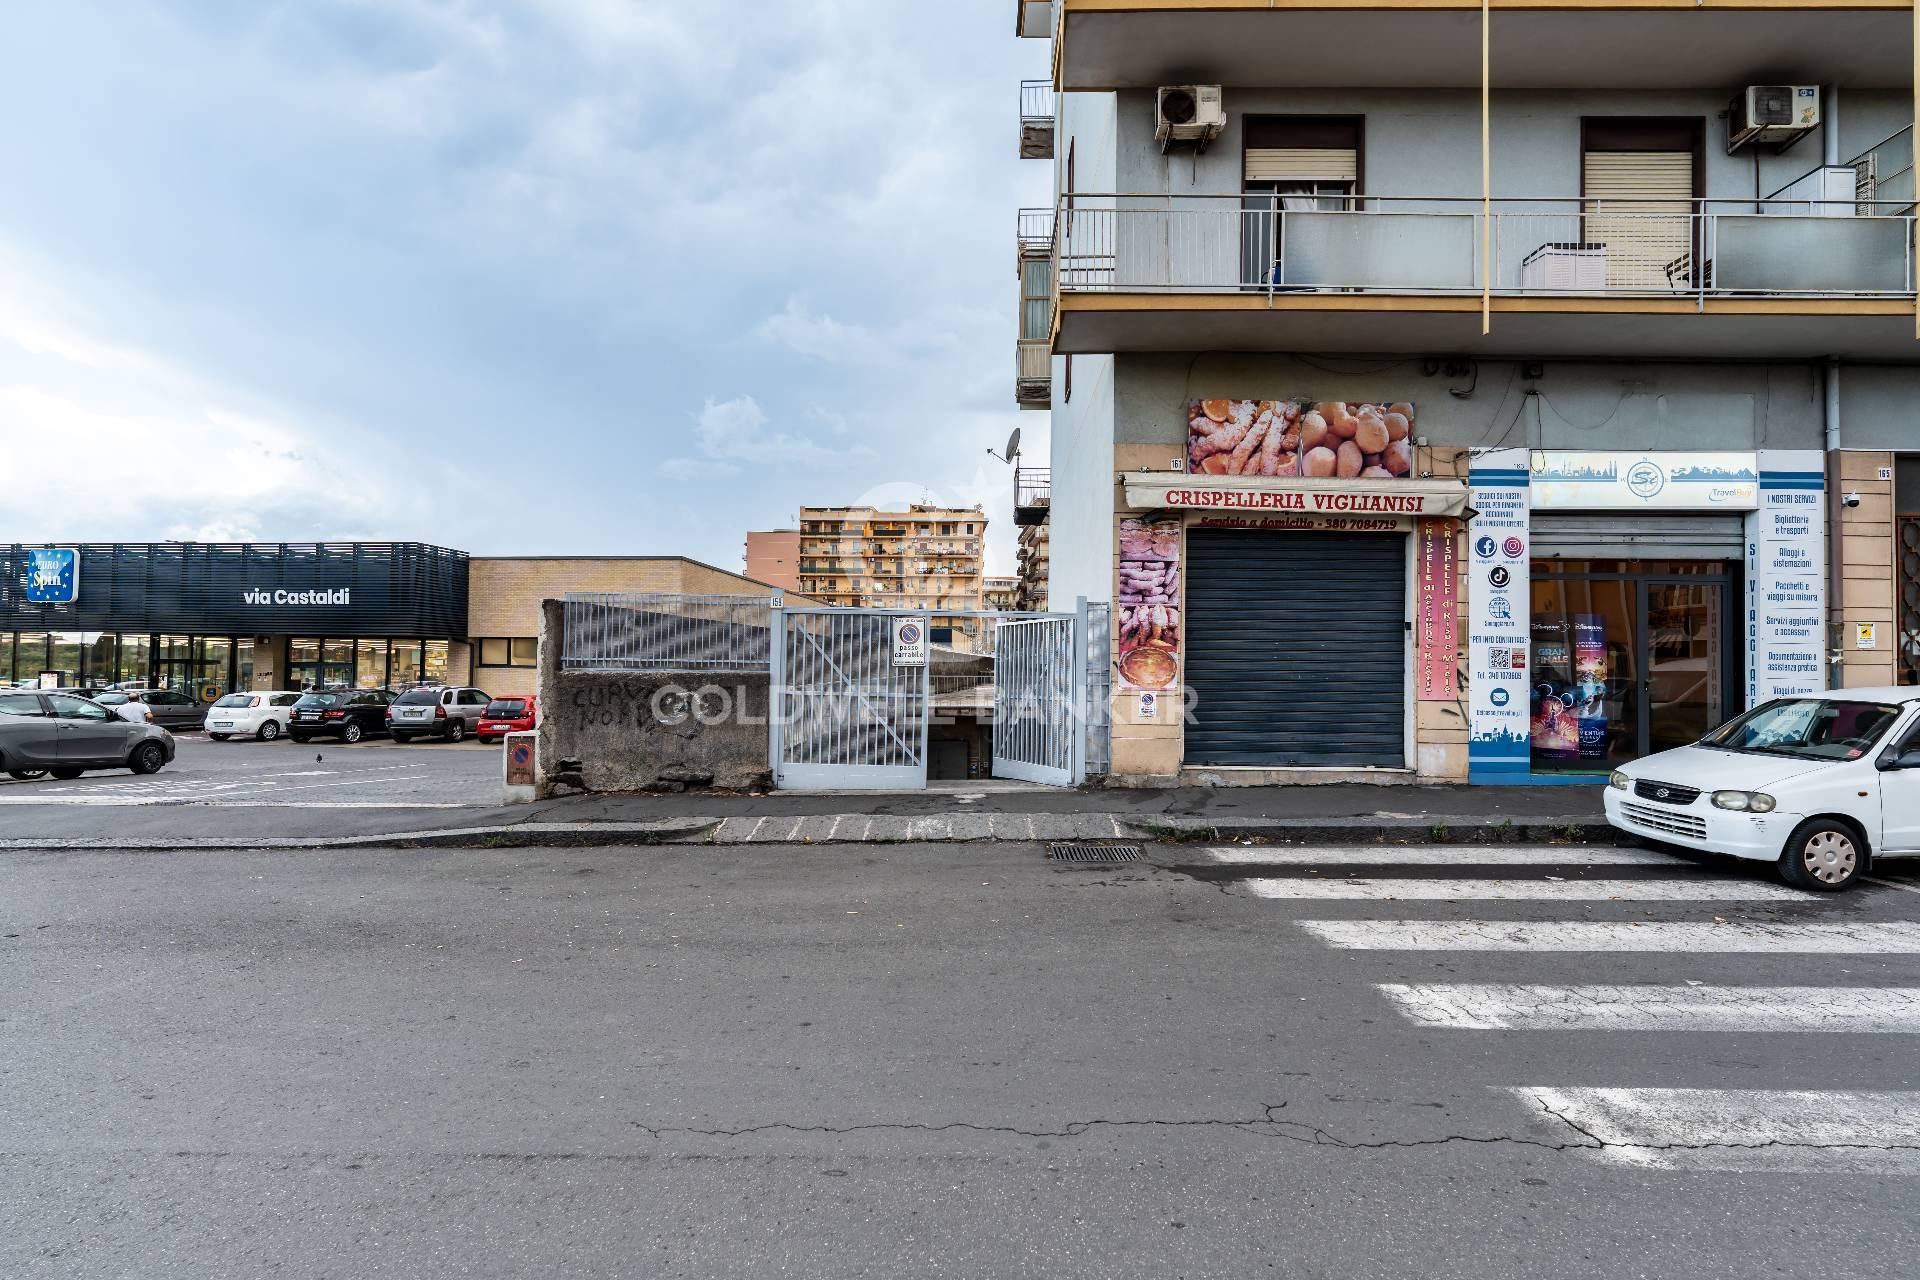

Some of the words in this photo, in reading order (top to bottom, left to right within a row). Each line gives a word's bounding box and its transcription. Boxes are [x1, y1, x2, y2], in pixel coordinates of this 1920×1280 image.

[1171, 459, 1182, 468] 161
[1879, 469, 1890, 478] 165
[1166, 490, 1306, 509] CRISPELLERIA
[1313, 494, 1425, 513] VIGLIANISI
[1772, 494, 1793, 503] NOSTRI
[1795, 495, 1817, 504] SERVIZI
[1201, 516, 1247, 528] Servizio
[1261, 517, 1315, 529] domicilio
[1325, 518, 1347, 529] 380
[1350, 519, 1398, 530] 7084719
[1781, 526, 1809, 536] trasporti
[1749, 543, 1756, 571] SI
[1779, 547, 1800, 559] Alloggi
[1444, 523, 1452, 595] CRISPELLE
[1773, 558, 1812, 568] sistemazioni
[37, 560, 60, 570] EURO
[33, 570, 62, 591] Spin
[1775, 581, 1804, 591] Pacchetti
[243, 587, 271, 605] via
[274, 587, 350, 605] Castaldi
[1767, 591, 1786, 603] viaggi
[1786, 593, 1795, 601] su
[1795, 592, 1818, 602] misura
[1442, 599, 1454, 608] di
[1766, 615, 1788, 625] Servizi
[1788, 616, 1819, 627] aggiuntivi
[1538, 648, 1567, 656] GRAN
[1535, 656, 1569, 664] FINALE
[1442, 654, 1454, 693] Miele
